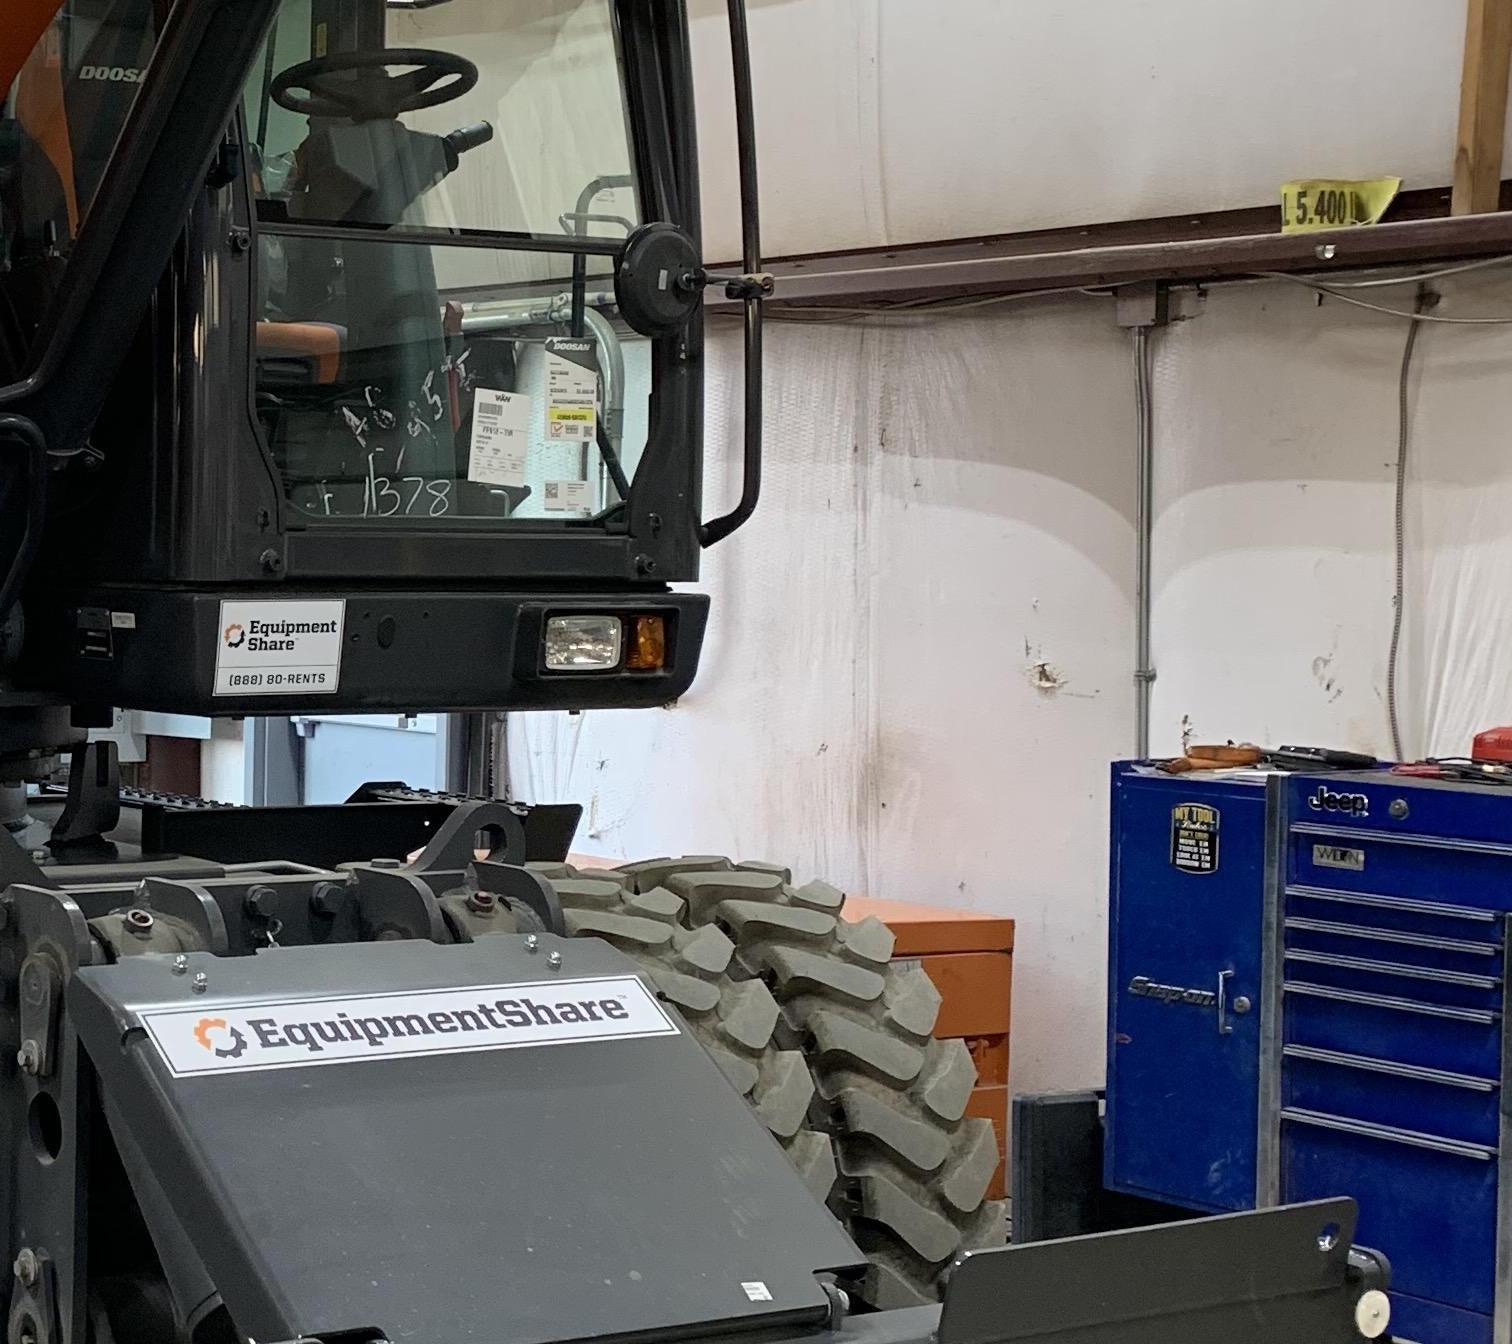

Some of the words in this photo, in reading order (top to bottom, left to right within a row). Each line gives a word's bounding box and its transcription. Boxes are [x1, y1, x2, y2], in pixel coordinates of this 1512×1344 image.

[1296, 189, 1346, 225] 5.400
[553, 342, 591, 351] DOOSAN
[249, 620, 337, 637] Equipment
[248, 637, 295, 651] Share
[229, 674, 263, 686] (888)
[266, 673, 326, 685] 80-RENTS
[1308, 785, 1369, 817] Jeep
[1128, 976, 1215, 1006] Snap-on
[246, 998, 629, 1052] EquipmentShare
